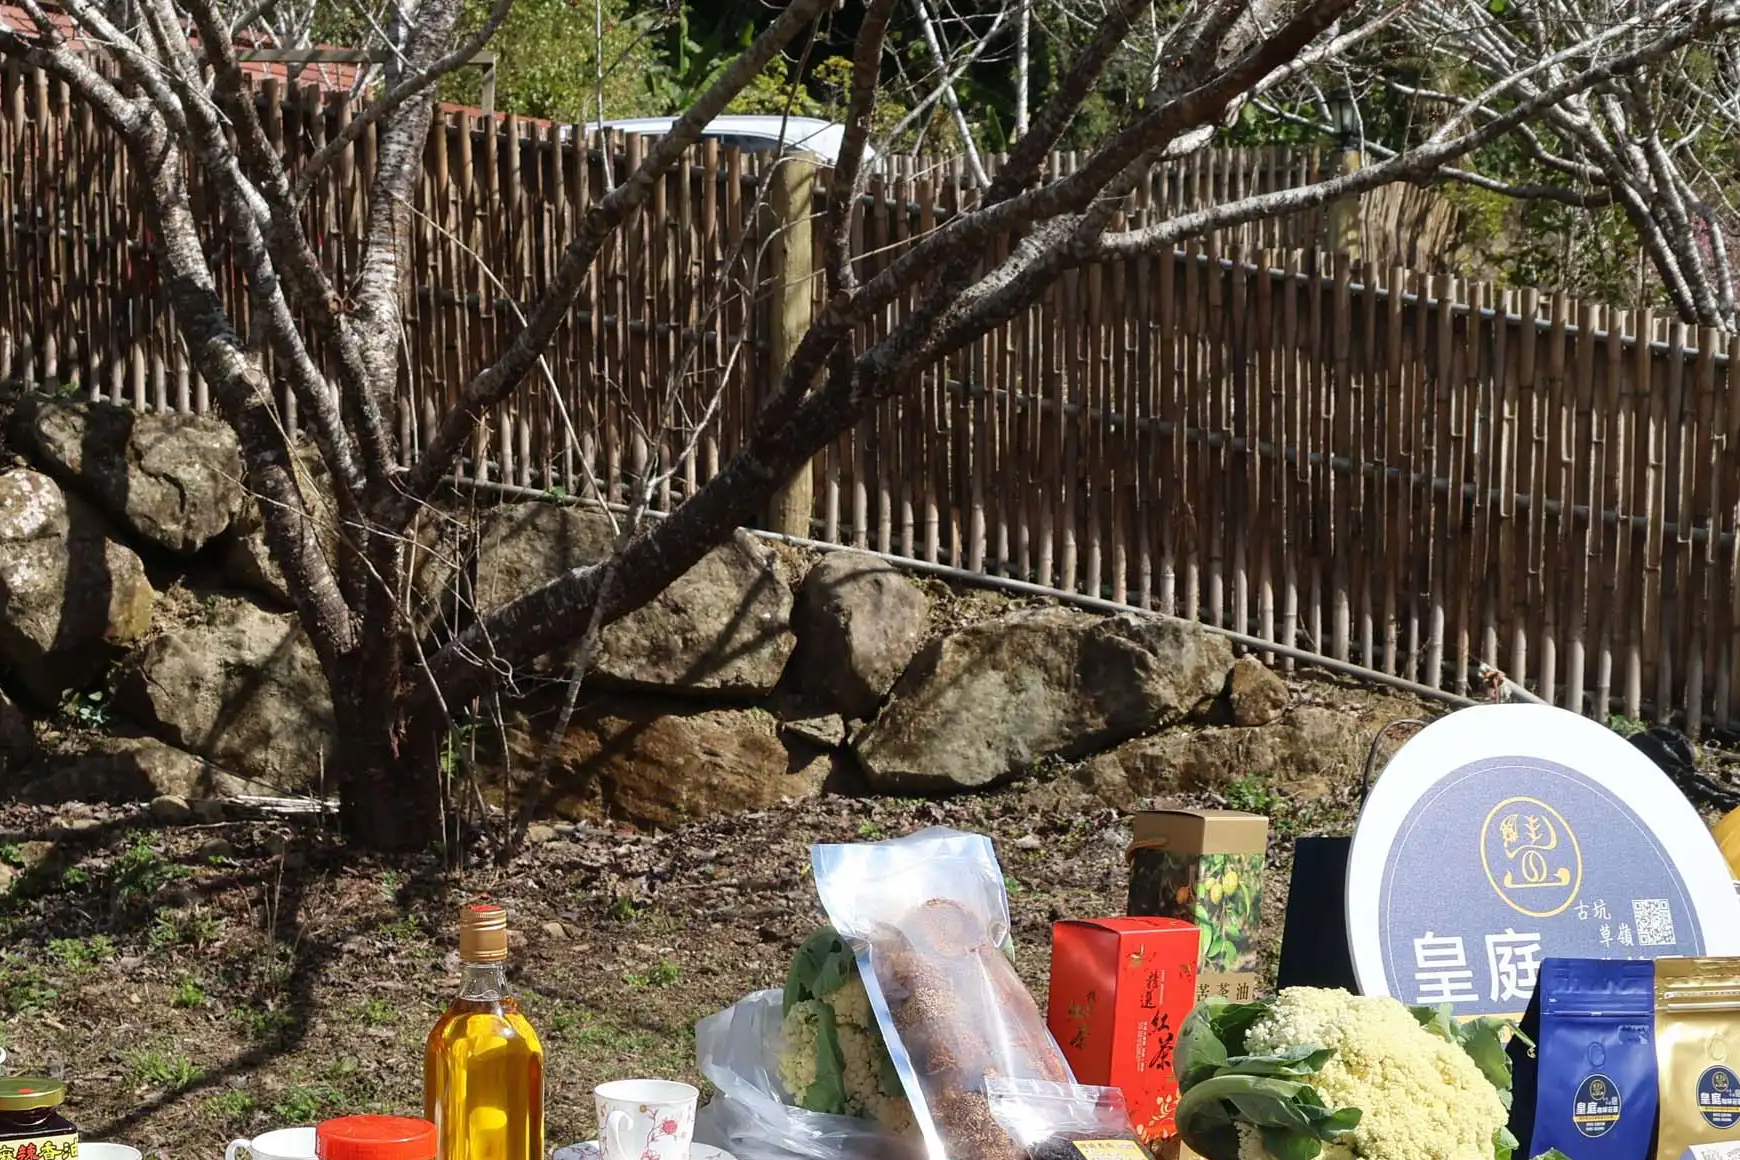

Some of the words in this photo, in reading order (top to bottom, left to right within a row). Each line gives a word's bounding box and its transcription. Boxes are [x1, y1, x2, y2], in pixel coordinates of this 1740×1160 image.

[1573, 899, 1612, 921] 古坑
[1598, 921, 1635, 948] 草嶺
[1413, 927, 1543, 1005] 皇庭
